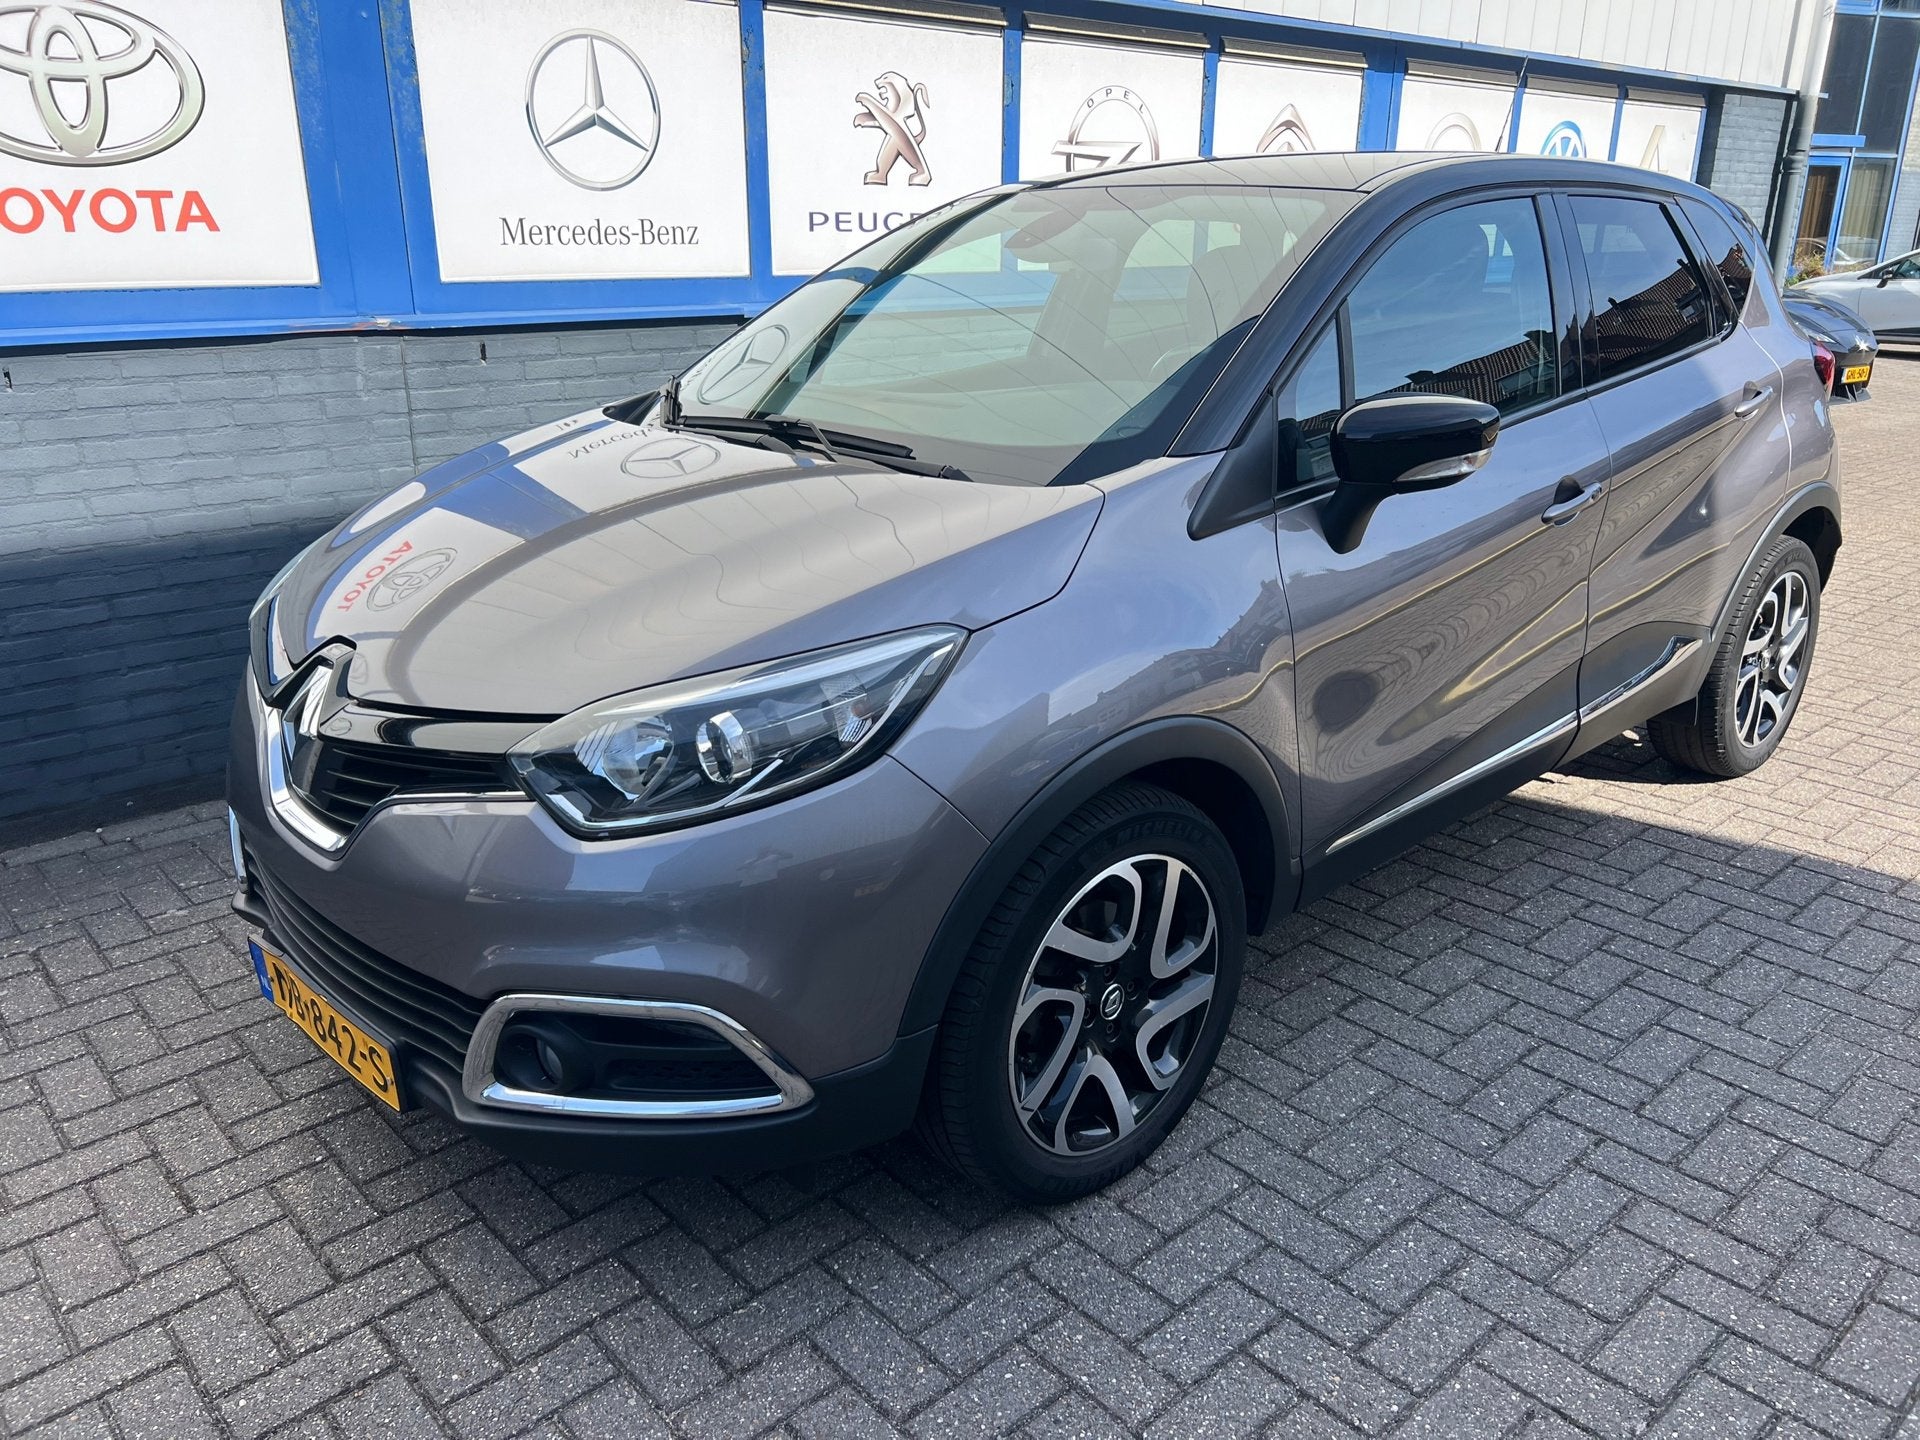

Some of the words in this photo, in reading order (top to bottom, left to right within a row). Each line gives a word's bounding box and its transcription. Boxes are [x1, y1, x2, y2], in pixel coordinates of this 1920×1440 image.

[1086, 88, 1144, 114] OPEL
[0, 187, 221, 235] OYOTA
[808, 211, 924, 233] PEUG
[500, 216, 700, 247] Mercedes-Benz
